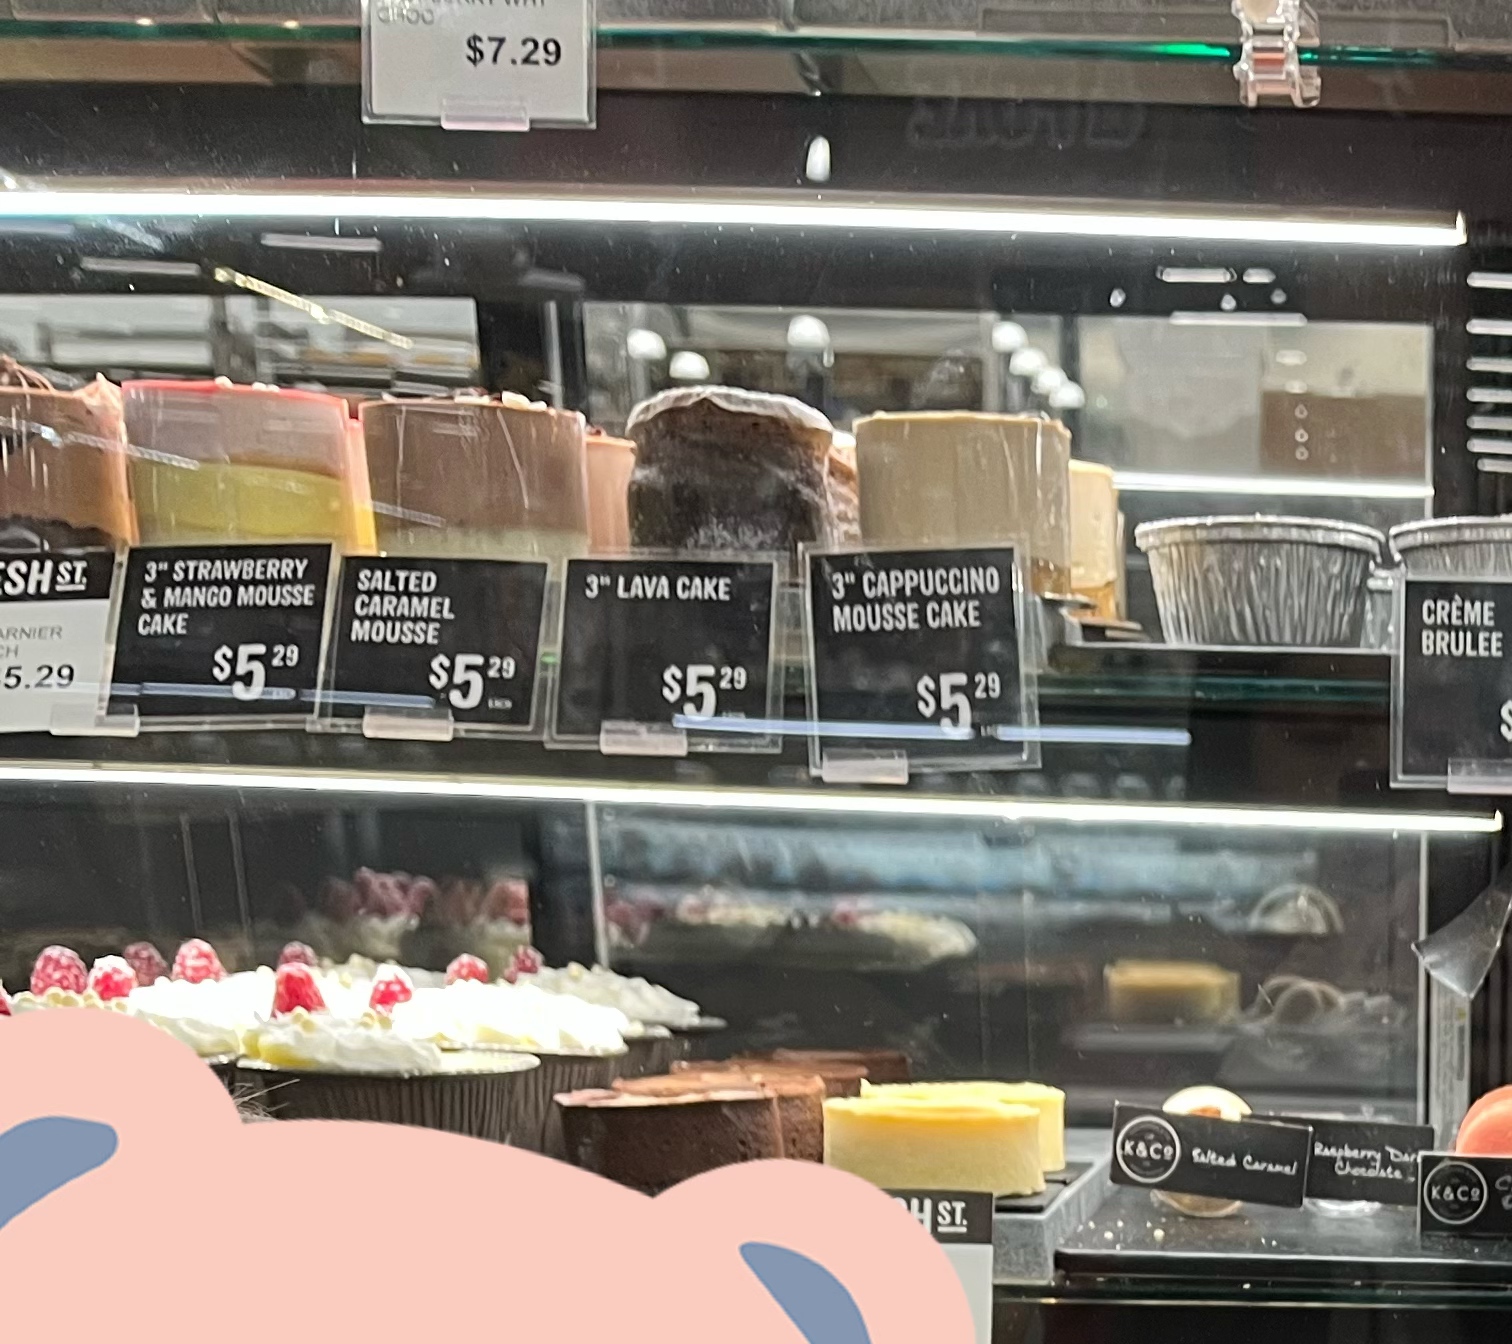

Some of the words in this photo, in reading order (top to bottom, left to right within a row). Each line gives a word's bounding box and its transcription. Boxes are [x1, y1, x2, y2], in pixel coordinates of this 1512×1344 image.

[466, 33, 562, 67] $7.29
[144, 560, 168, 583] 3"
[172, 558, 309, 582] STRAWBERRY
[357, 568, 438, 593] SALTED
[831, 572, 856, 600] 3"
[862, 566, 1000, 599] CAPPUCCINO
[141, 588, 157, 609] &
[163, 586, 231, 608] MANGO
[237, 584, 316, 607] MOUSSE
[585, 573, 611, 599] 3"
[617, 574, 670, 600] LAVA
[676, 576, 732, 601] CAKE
[354, 594, 455, 620] CARAMEL
[832, 602, 919, 633] MOUSSE
[926, 600, 982, 629] CAKE
[1422, 593, 1496, 627] CRÈME
[137, 613, 190, 636] CAKE
[351, 618, 441, 645] MOUSSE
[1421, 629, 1503, 657] BRULEE
[1384, 1145, 1417, 1162] Dar
